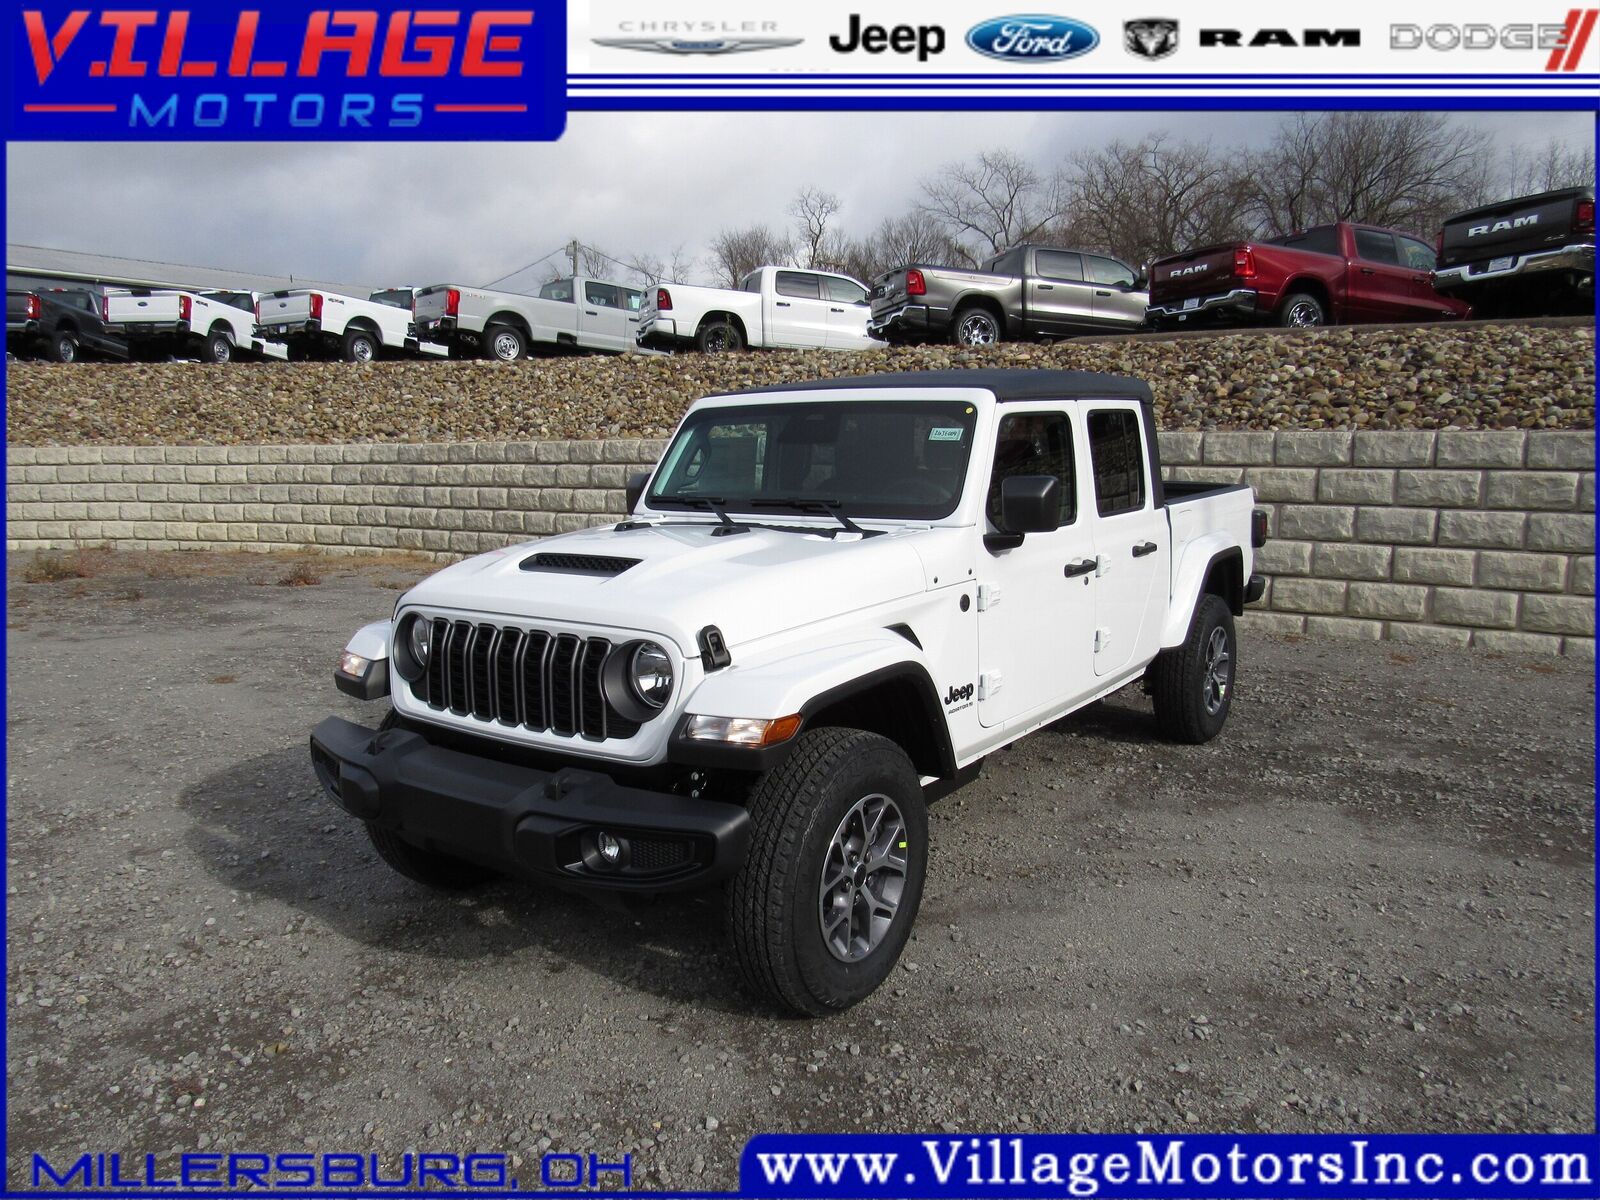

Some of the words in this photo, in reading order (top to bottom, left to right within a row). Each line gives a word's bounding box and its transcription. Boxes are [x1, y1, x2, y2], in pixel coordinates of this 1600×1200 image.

[1468, 214, 1538, 238] RAM
[1169, 263, 1208, 278] RAM
[944, 682, 974, 705] Jeep
